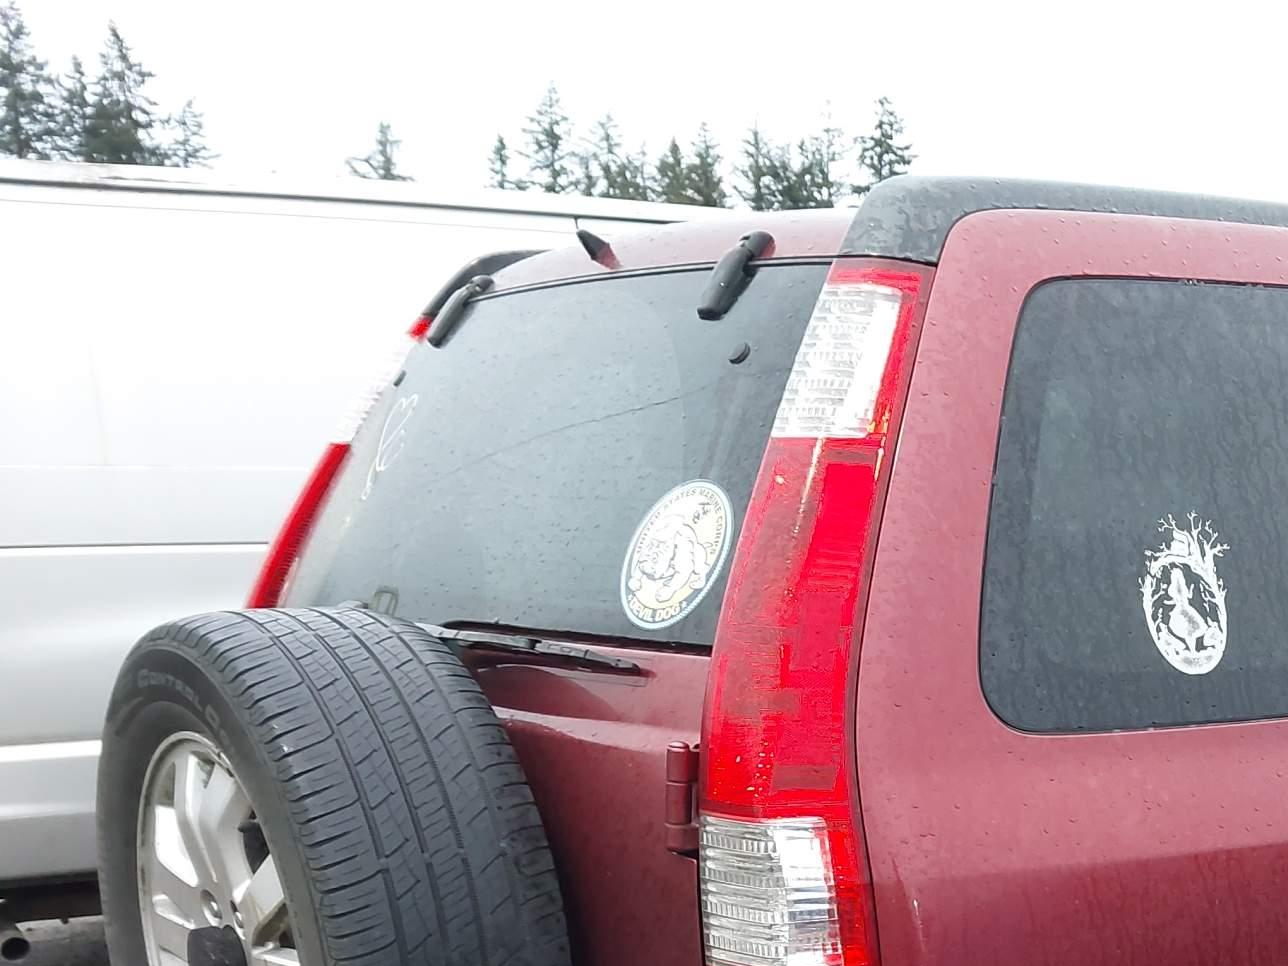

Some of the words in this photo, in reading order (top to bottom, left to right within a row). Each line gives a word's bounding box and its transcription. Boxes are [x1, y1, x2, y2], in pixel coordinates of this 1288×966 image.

[698, 488, 723, 515] MARINE
[629, 598, 655, 622] DEVIL
[655, 605, 681, 622] DOG
